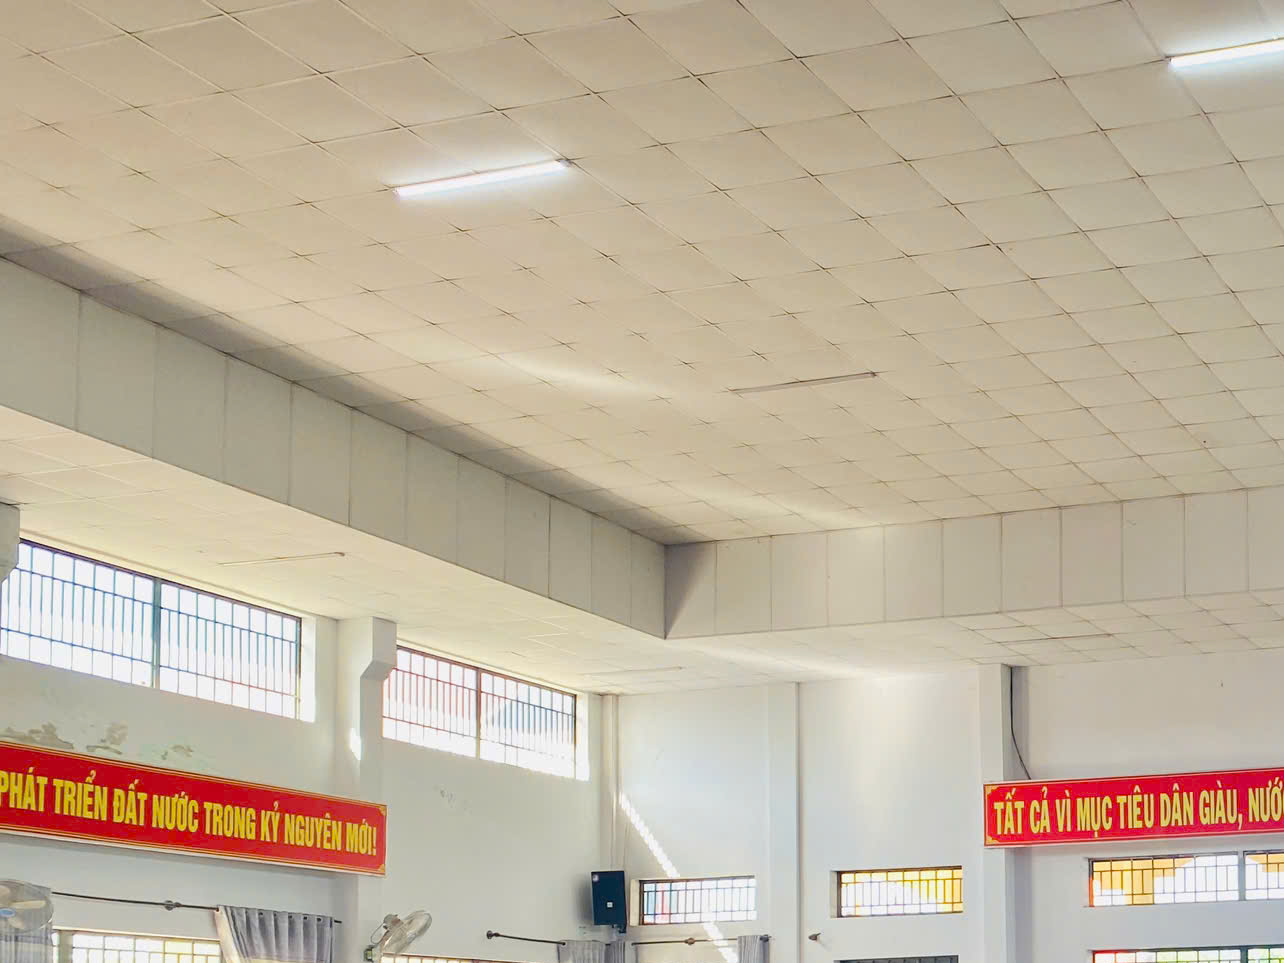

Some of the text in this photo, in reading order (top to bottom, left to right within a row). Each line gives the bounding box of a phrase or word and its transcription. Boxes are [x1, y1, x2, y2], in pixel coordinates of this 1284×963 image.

[0, 766, 377, 856] PHÁT TRIỂN ĐẤT NƯỚC TRONG KỶ NGUYÊN MỚI!
[994, 788, 1024, 834] TẤT
[1030, 786, 1051, 833] CẢ
[1056, 790, 1071, 832] VÌ
[1076, 796, 1112, 838] MỤC
[1116, 785, 1154, 829] TIÊU
[1160, 783, 1194, 827] DÂN
[1199, 780, 1242, 830] GIÀU,
